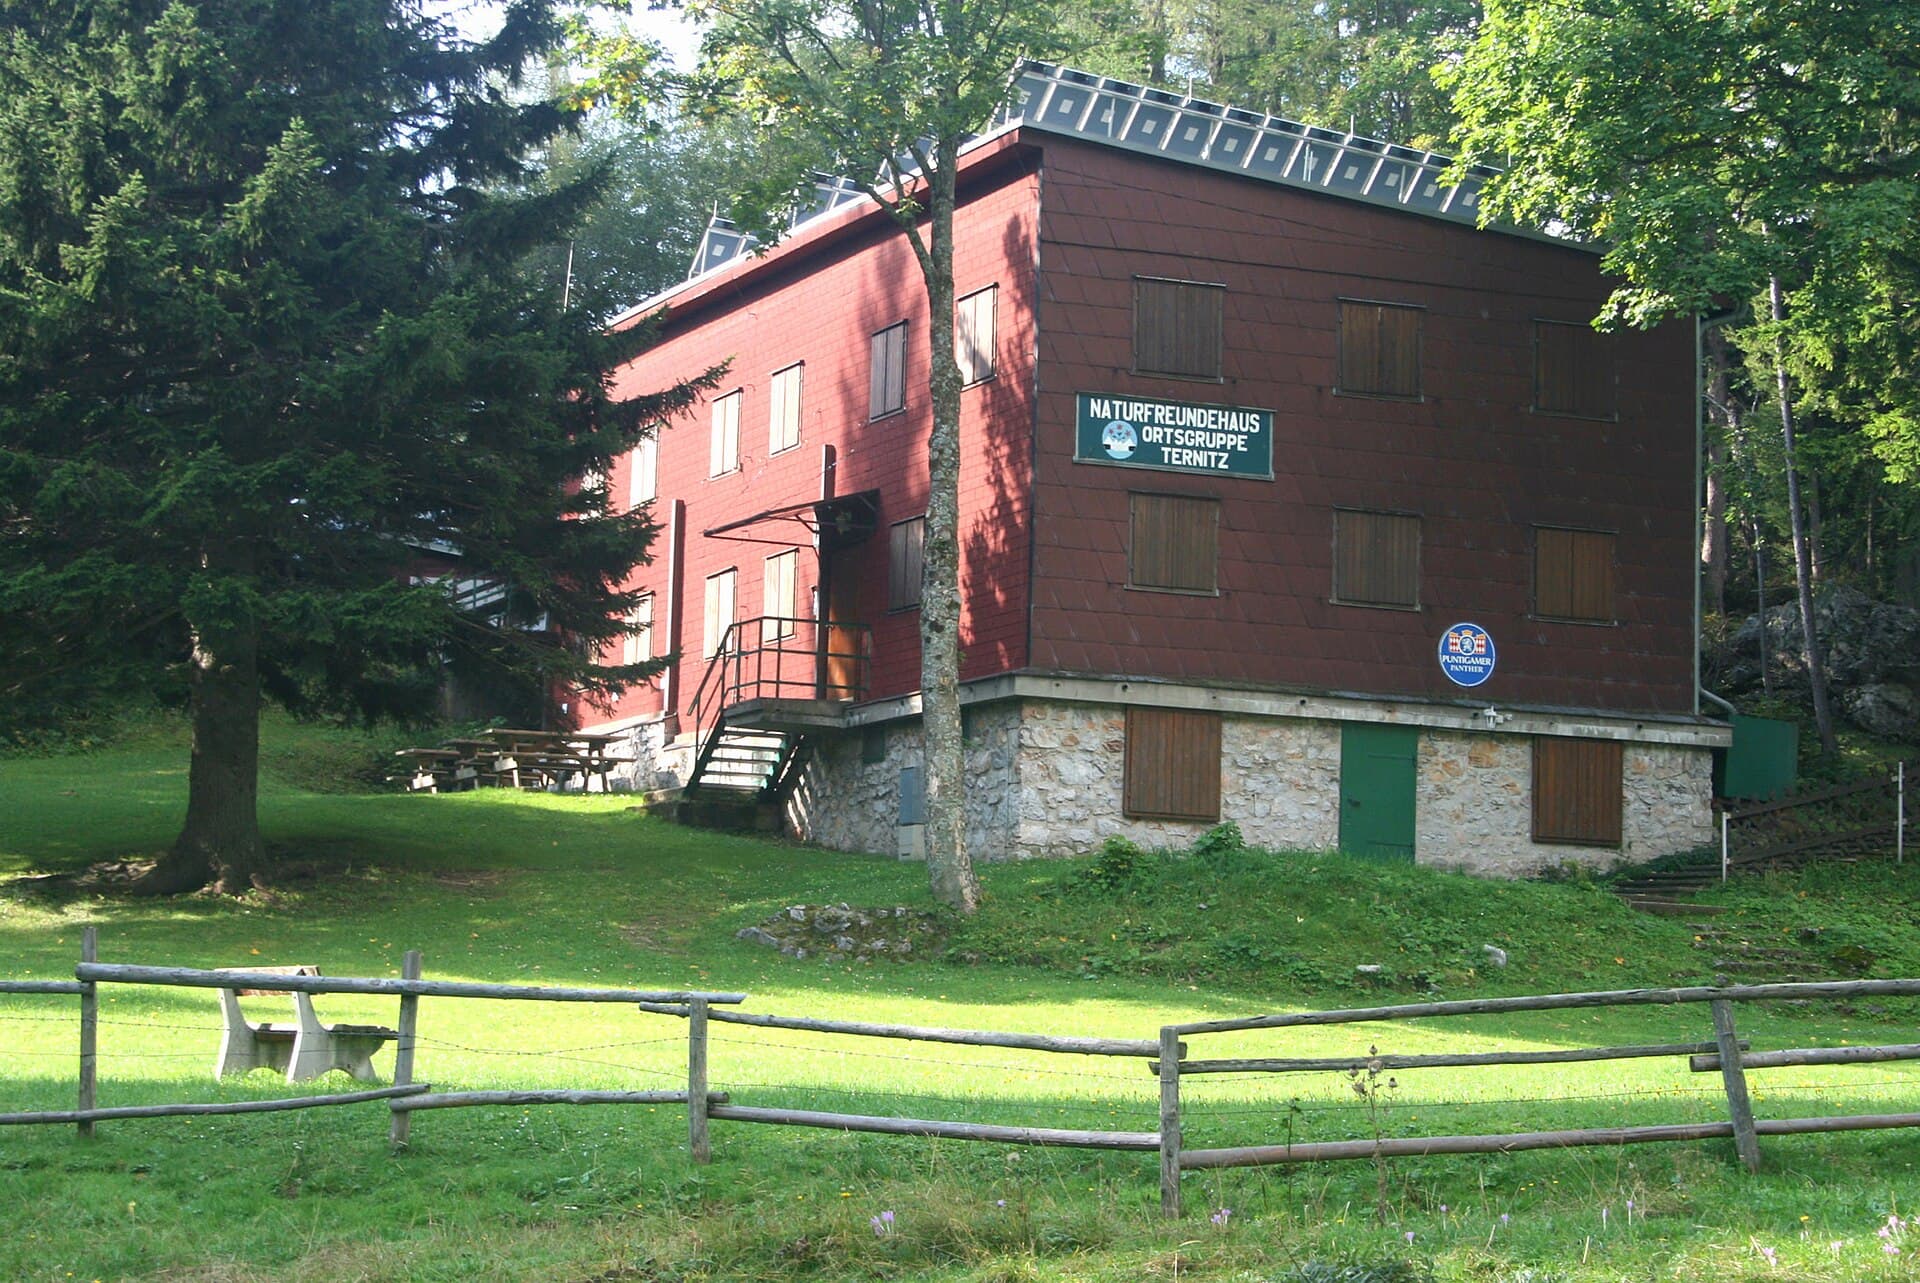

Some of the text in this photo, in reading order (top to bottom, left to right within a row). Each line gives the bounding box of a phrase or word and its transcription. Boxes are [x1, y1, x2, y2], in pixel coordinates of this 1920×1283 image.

[1090, 398, 1260, 433] NATURFREUNDEHAUS
[1142, 426, 1248, 452] ORTSGRUPPE
[1161, 447, 1229, 469] TERNITZ
[1442, 655, 1491, 666] PUNTIGAMER
[1450, 665, 1484, 673] PANTHER
